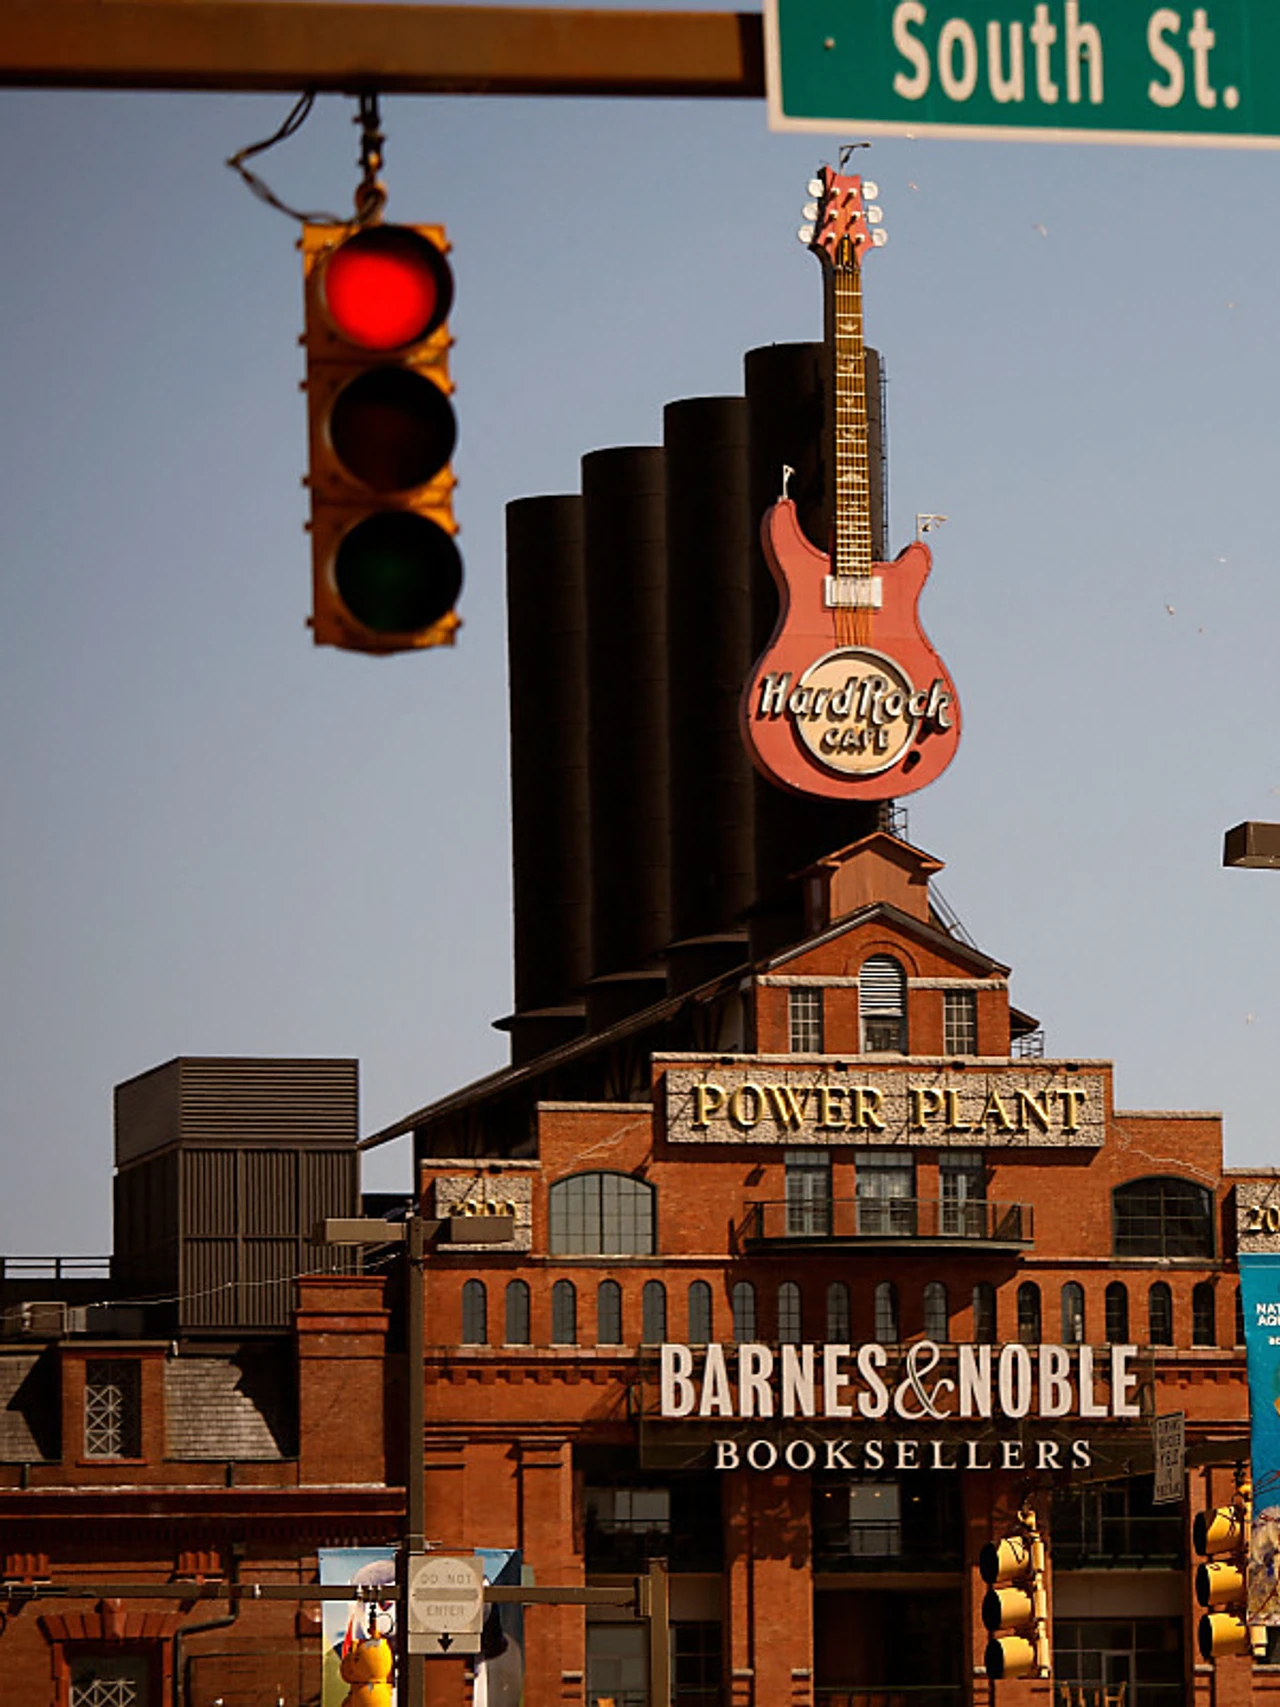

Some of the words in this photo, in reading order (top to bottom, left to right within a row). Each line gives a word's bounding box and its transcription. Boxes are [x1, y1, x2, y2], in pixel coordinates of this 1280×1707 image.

[893, 0, 1104, 104] South
[1147, 8, 1240, 109] St.
[758, 671, 857, 720] Hard
[857, 674, 953, 728] Rock
[691, 1083, 888, 1131] POWER
[909, 1087, 1088, 1134] PLANT
[661, 1343, 890, 1419] BARNES
[958, 1344, 1142, 1418] NOBLE
[714, 1439, 1093, 1470] BOOKSELLERS
[420, 1573, 438, 1585] DO
[448, 1573, 473, 1585] NOT
[426, 1604, 466, 1617] ENTER
